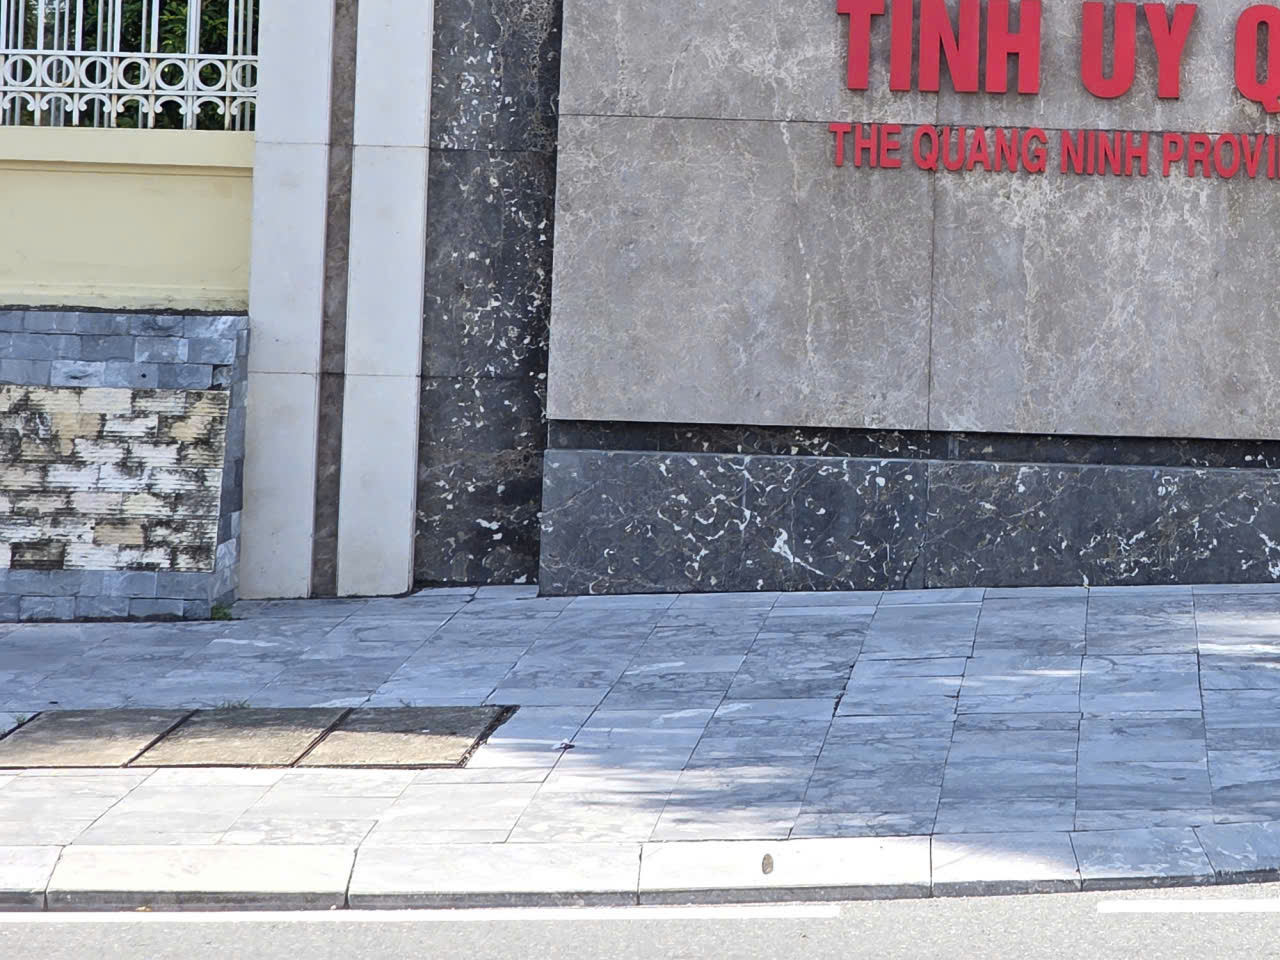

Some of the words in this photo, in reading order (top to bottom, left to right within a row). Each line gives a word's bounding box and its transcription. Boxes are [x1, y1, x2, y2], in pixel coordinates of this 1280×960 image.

[828, 122, 902, 169] THE
[912, 123, 1048, 175] QUANG
[1060, 129, 1150, 177] NINH
